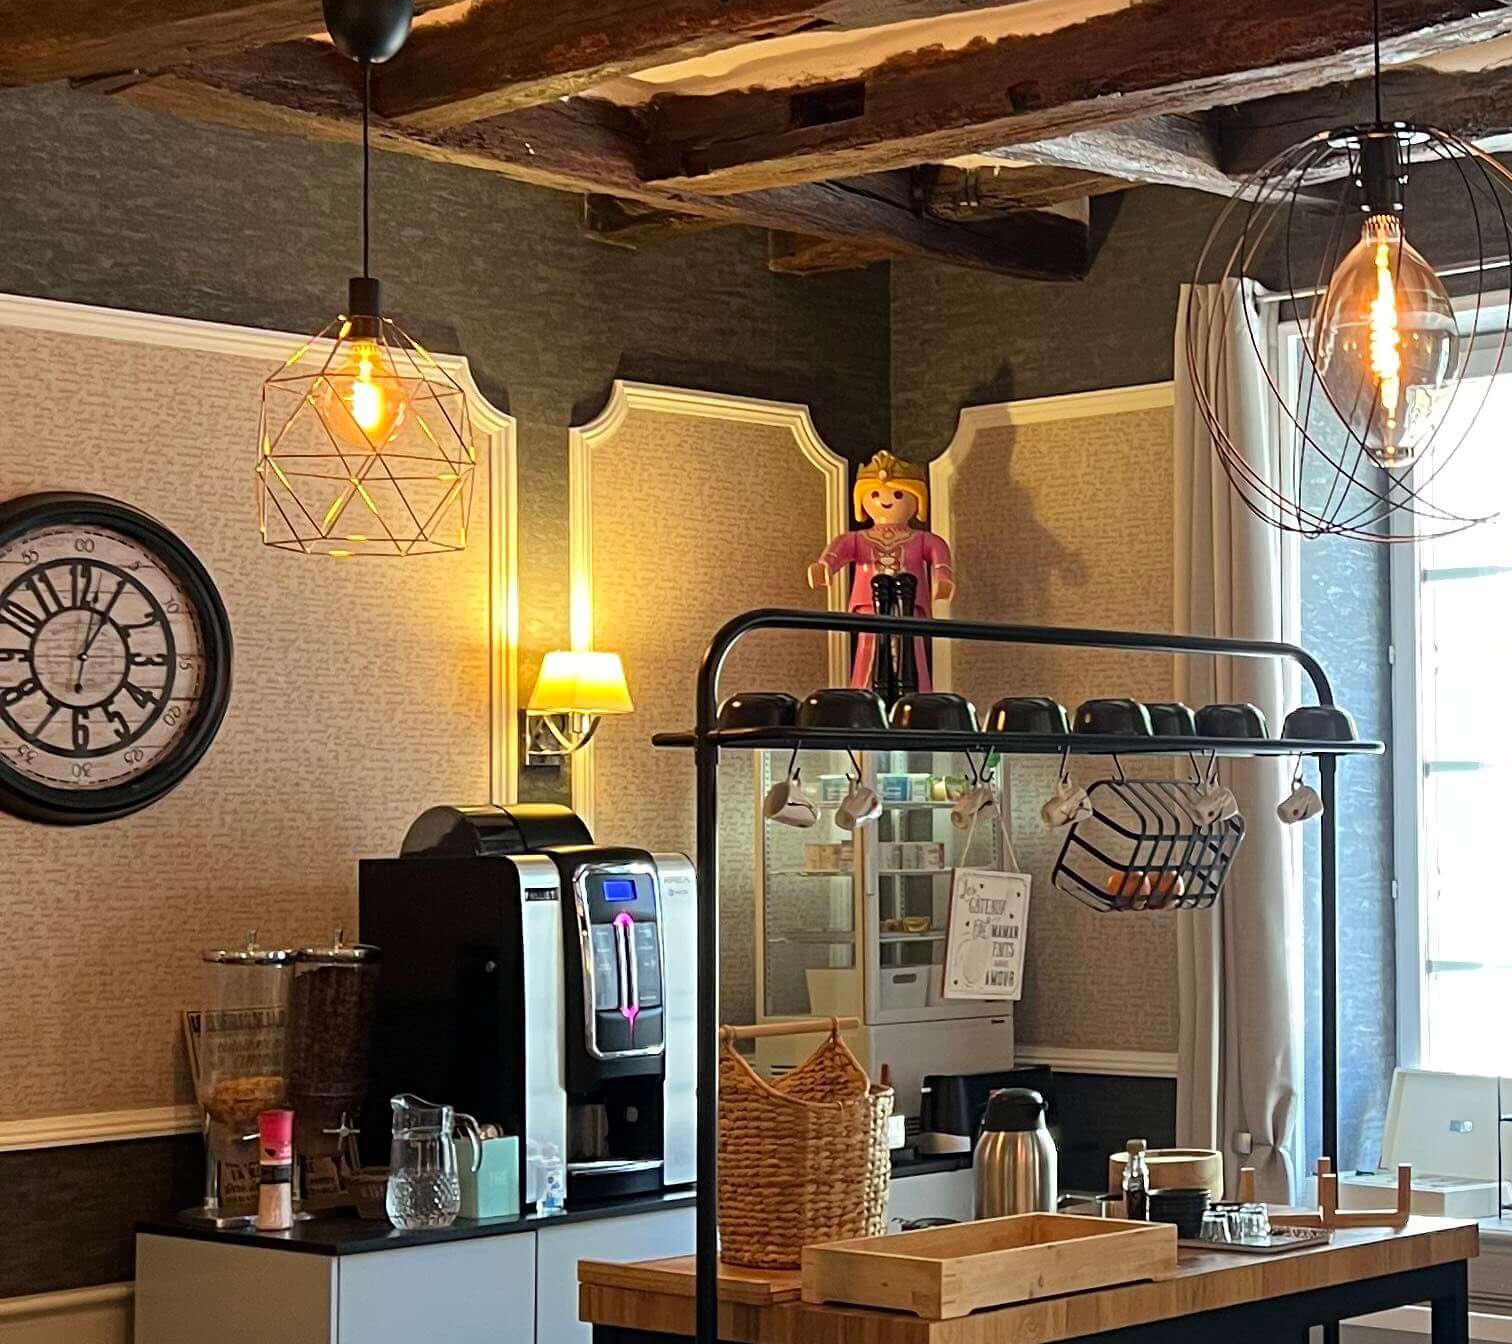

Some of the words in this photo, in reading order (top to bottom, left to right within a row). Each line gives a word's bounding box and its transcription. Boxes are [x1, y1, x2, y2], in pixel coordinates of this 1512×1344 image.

[74, 537, 95, 554] 60
[25, 570, 65, 617] 11
[69, 561, 92, 608] 12
[129, 652, 170, 667] 3
[0, 677, 40, 707] 8
[123, 681, 163, 709] 4
[72, 708, 90, 752] 6
[102, 700, 131, 742] 5
[72, 762, 92, 778] 30
